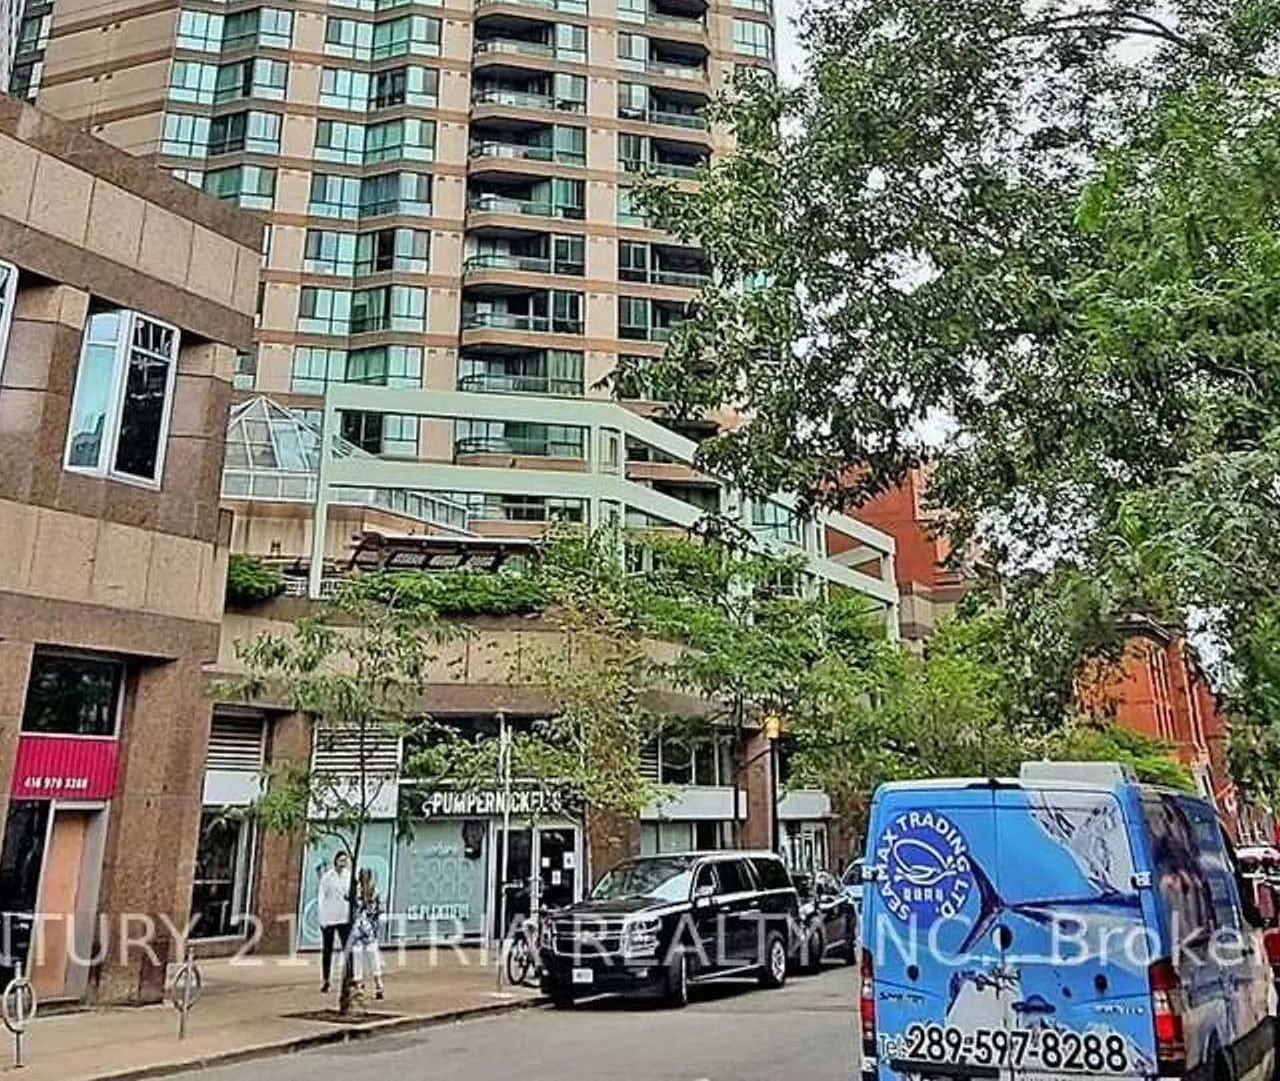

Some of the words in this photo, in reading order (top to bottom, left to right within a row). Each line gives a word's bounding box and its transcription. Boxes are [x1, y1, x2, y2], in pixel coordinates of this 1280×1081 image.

[432, 791, 561, 814] PUMPERNCKEL'S
[877, 828, 911, 921] SEAMAX
[896, 811, 971, 873] TRADING
[906, 1024, 1128, 1072] 289-597-8288
